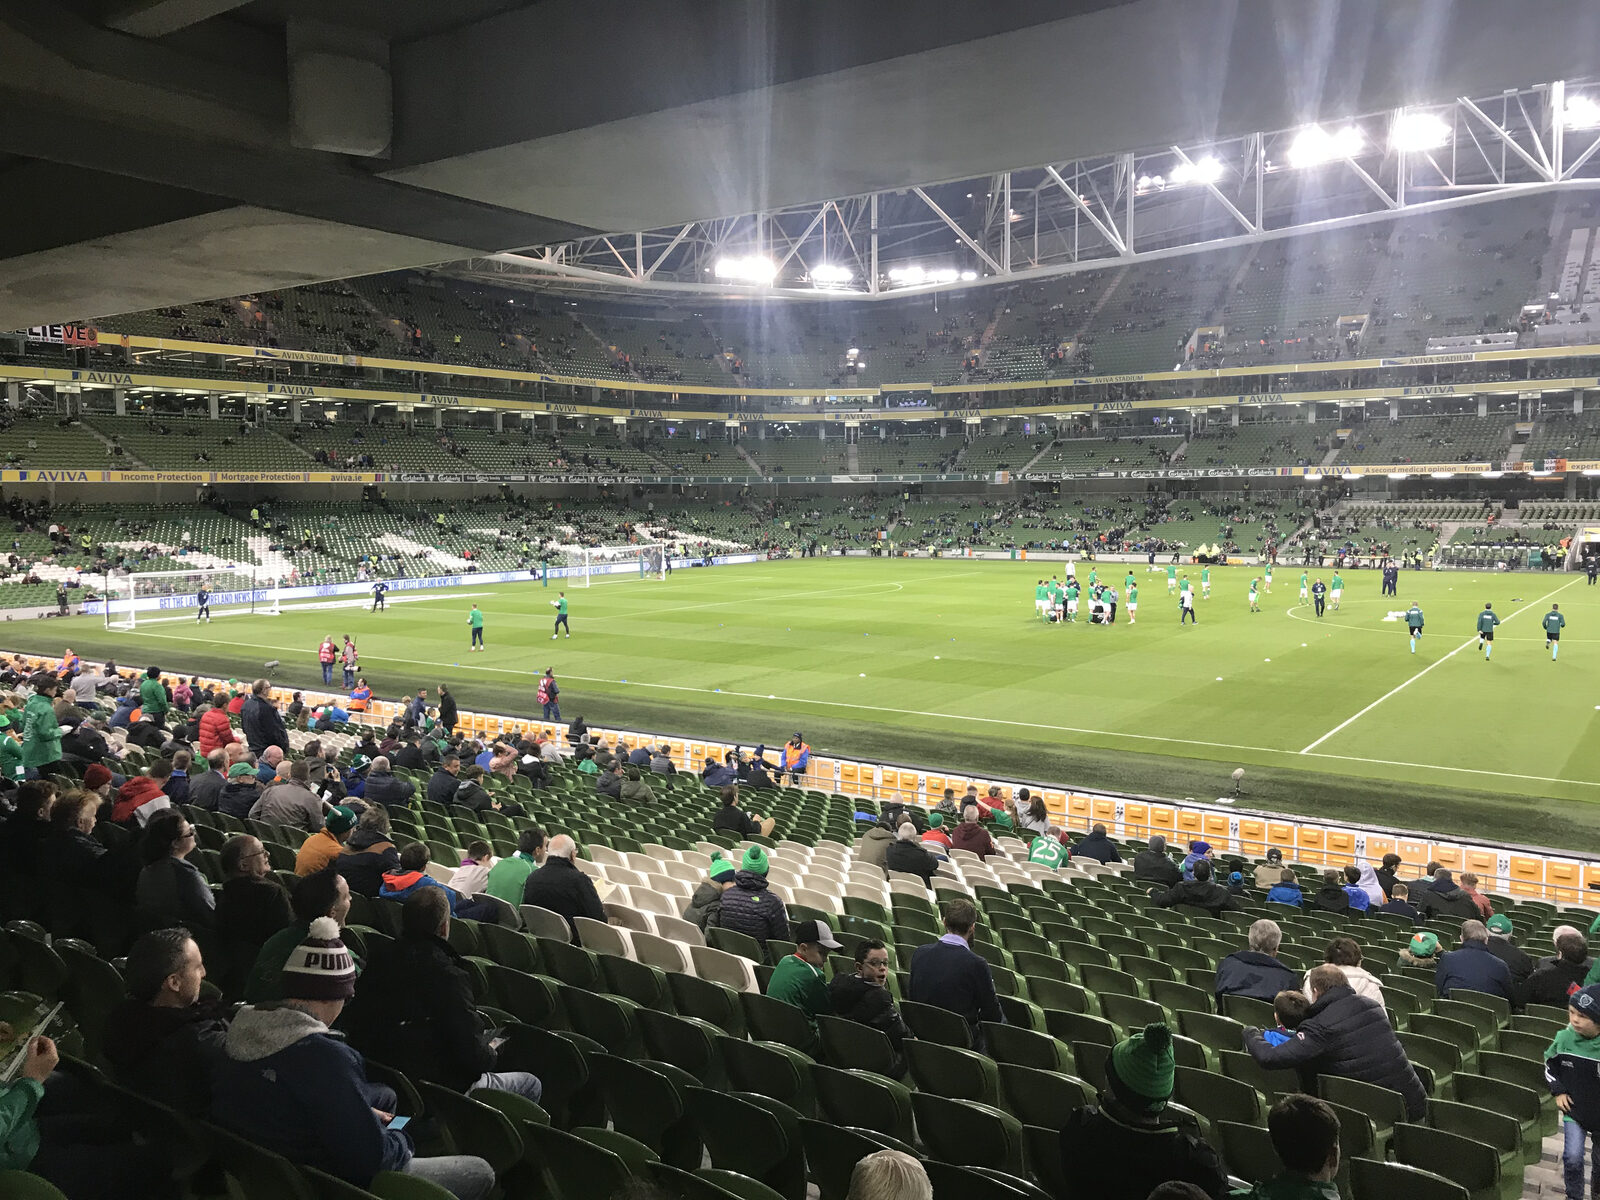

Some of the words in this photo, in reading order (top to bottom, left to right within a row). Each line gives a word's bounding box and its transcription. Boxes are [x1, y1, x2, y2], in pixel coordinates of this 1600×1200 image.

[282, 350, 304, 361] AVIVA
[306, 353, 338, 363] STADIUM
[1409, 355, 1434, 365] AVIVA
[1435, 353, 1474, 363] STADIUM
[87, 372, 132, 384] AVIVA
[1115, 375, 1143, 383] STADIUM
[279, 385, 314, 396] AVIVA
[1416, 387, 1455, 395] AVIVA
[430, 395, 458, 405] AVIVA
[1250, 394, 1283, 404] AVIVA
[553, 404, 577, 413] AVIVA
[1103, 401, 1133, 410] AVIVA
[637, 410, 663, 418] AVIVA
[736, 413, 764, 421] AVIVA
[844, 412, 872, 420] AVIVA
[952, 409, 980, 417] AVIVA
[1314, 467, 1352, 475] AVIVA
[1427, 465, 1456, 473] opinion
[1464, 464, 1483, 472] from
[36, 471, 88, 482] AVIVA
[120, 473, 154, 481] Income
[156, 473, 202, 481] Protection
[221, 473, 259, 482] Mortgage
[260, 473, 300, 481] Protection
[330, 474, 362, 482] aviva.ie
[160, 598, 170, 609] GET
[172, 596, 184, 608] THE
[234, 592, 250, 604] NEWS
[1032, 839, 1061, 861] 25
[304, 952, 354, 970] PUM
